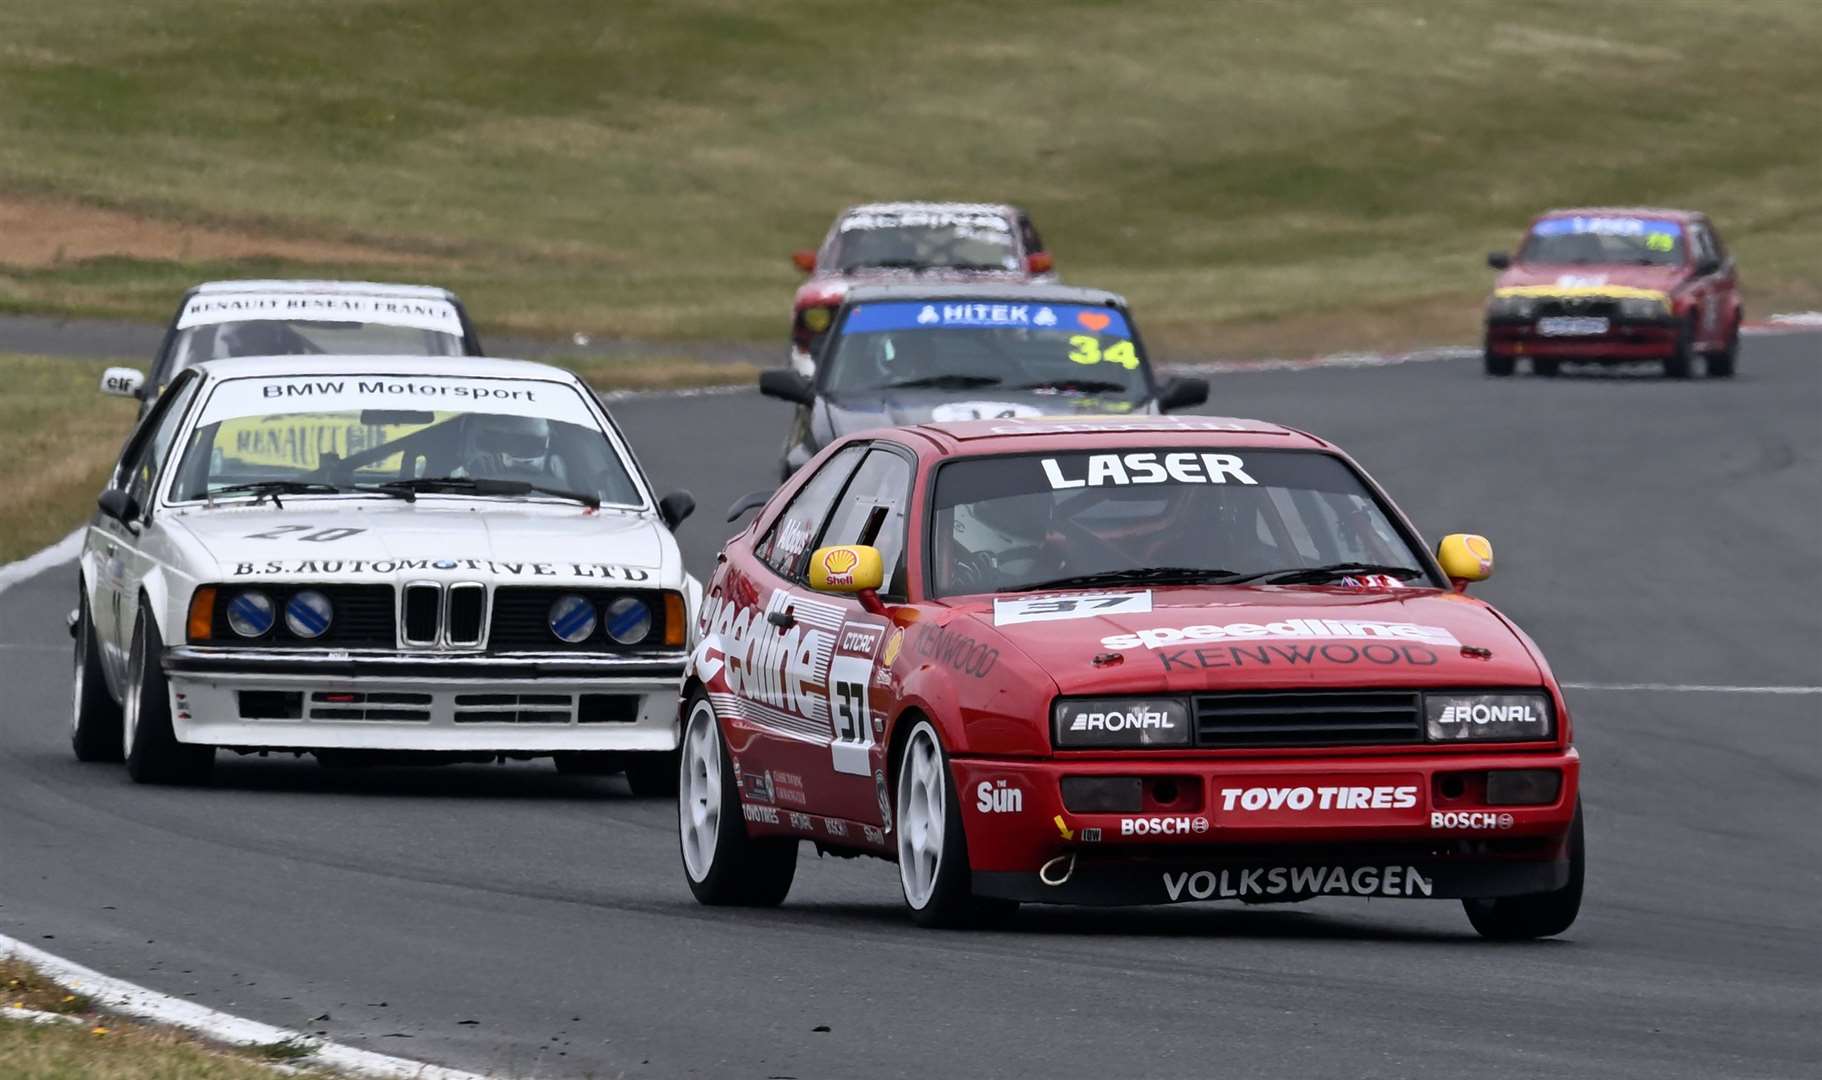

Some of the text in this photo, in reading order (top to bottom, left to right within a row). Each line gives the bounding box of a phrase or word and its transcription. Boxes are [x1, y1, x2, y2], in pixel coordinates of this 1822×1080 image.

[190, 300, 278, 314] RENAULT
[374, 301, 450, 319] FRANCE
[943, 305, 1029, 323] HITEK
[1068, 334, 1140, 370] 34
[107, 377, 134, 392] elf
[262, 381, 536, 402] BMW Motorsport
[1041, 453, 1259, 489] LASER
[243, 524, 368, 542] 20
[570, 563, 650, 582] LTD
[826, 575, 853, 585] Shell
[1019, 596, 1136, 615] 37
[1100, 619, 1432, 649] speedline
[1158, 644, 1439, 672] KENWOOD
[836, 681, 867, 744] 37
[1087, 711, 1175, 731] RONAL
[1455, 704, 1537, 724] RONAL
[977, 781, 1023, 813] Sun
[1221, 787, 1418, 811] TOYO TIRES
[1121, 817, 1191, 835] BOSCH
[1431, 812, 1496, 829] BOSCH
[1162, 866, 1432, 901] VOLKSWAGEN
